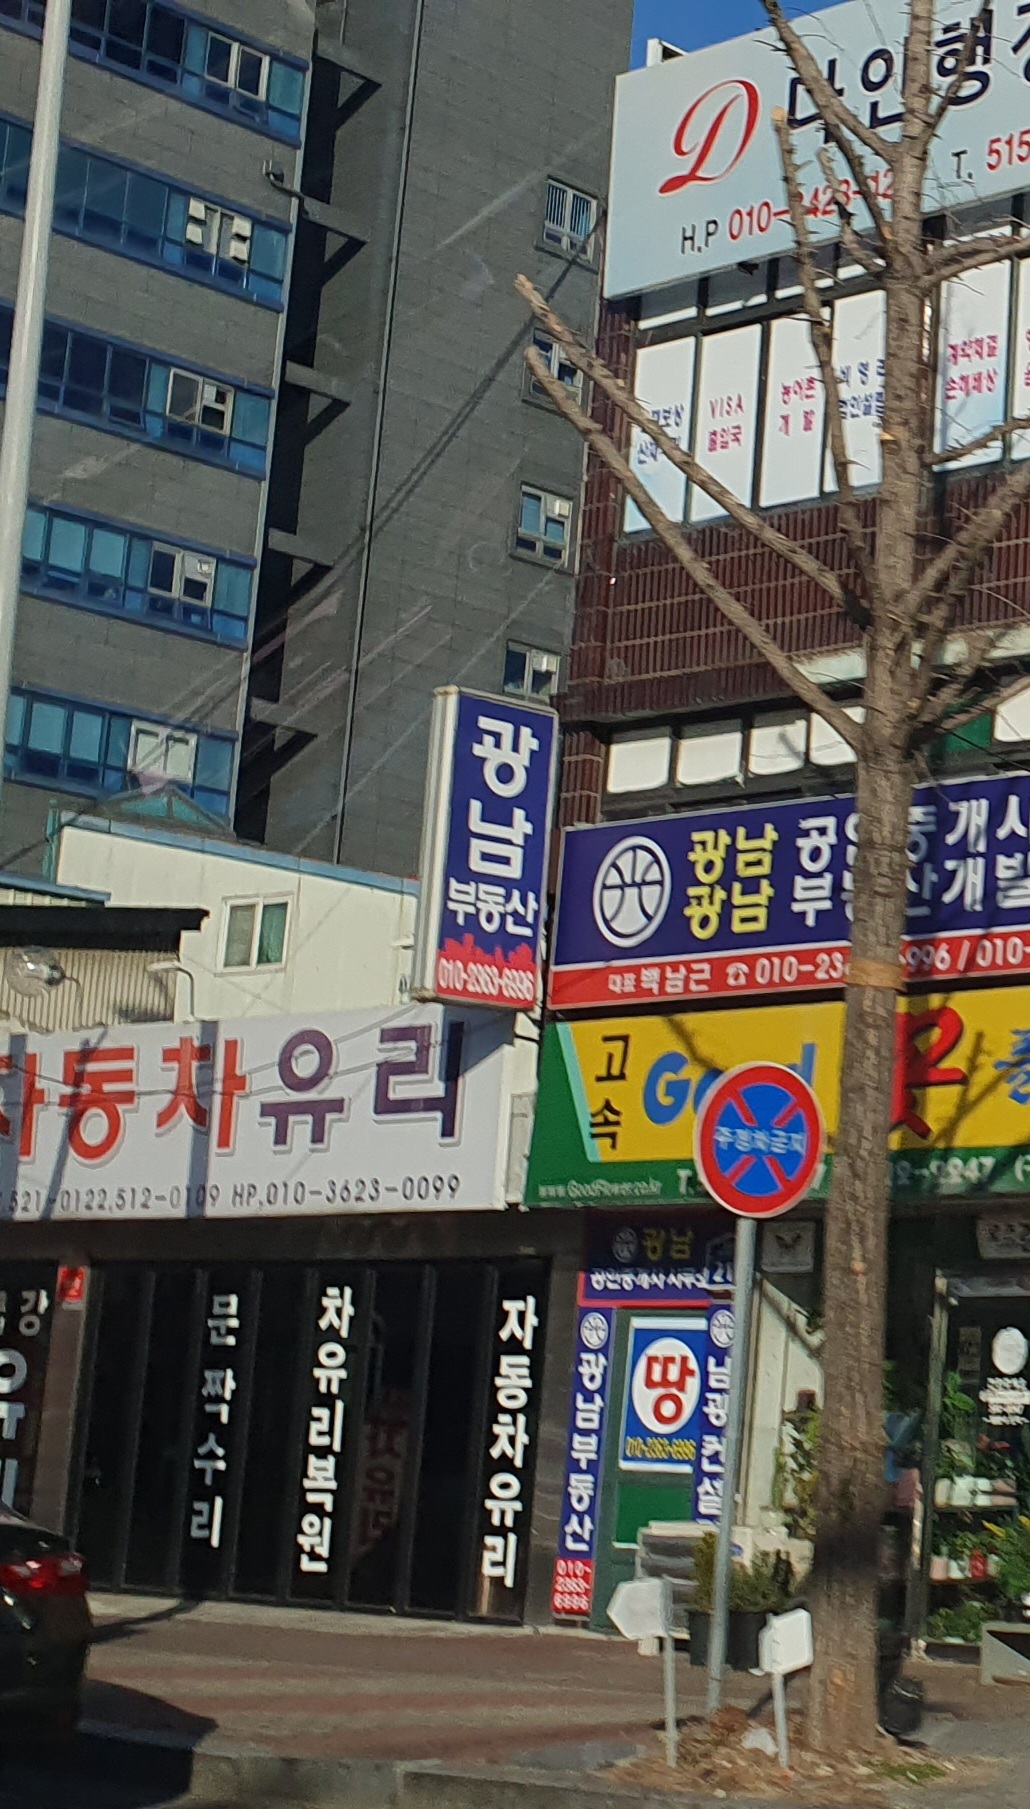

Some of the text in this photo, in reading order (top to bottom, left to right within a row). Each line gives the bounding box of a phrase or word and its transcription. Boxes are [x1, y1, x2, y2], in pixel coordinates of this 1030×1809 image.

[709, 393, 743, 419] VISA
[469, 714, 540, 879] 광남
[687, 822, 780, 886] 광남
[446, 877, 539, 938] 부동산
[682, 878, 775, 941] 광남
[644, 1355, 696, 1425] 땅
[296, 1285, 356, 1573] 차유리복원
[480, 1294, 540, 1589] 자동차유리
[563, 1351, 608, 1552] 광남부동산
